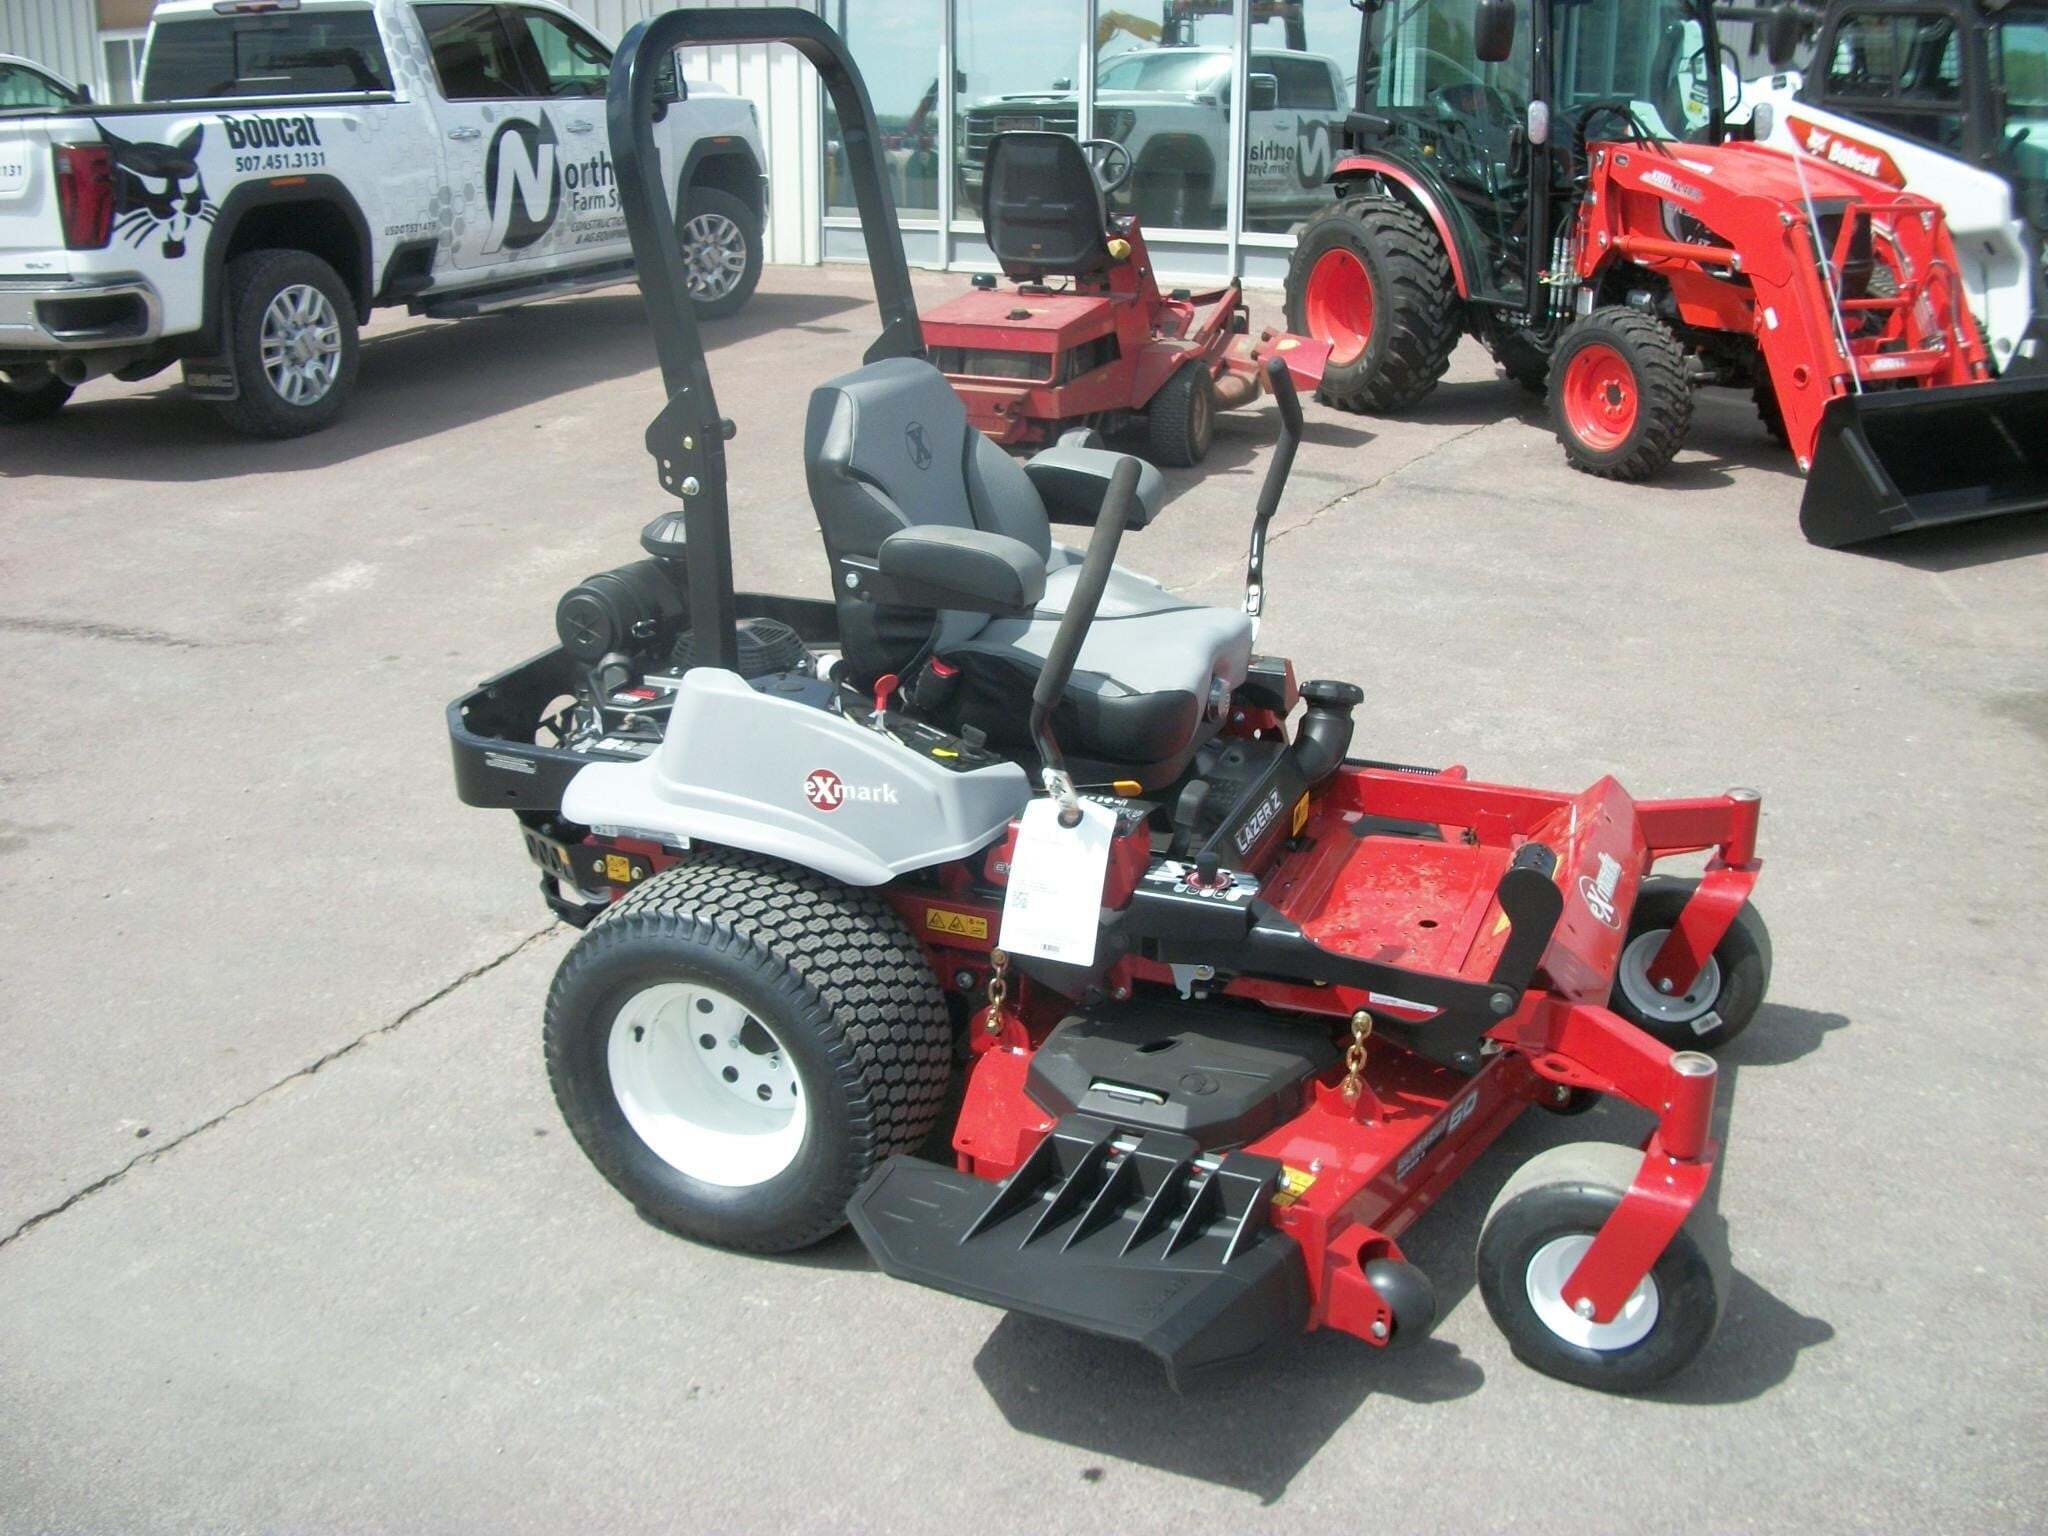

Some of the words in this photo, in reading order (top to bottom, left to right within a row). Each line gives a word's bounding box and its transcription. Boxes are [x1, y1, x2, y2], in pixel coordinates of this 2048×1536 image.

[216, 113, 321, 149] Bobcat
[235, 151, 326, 173] 507.451.3131
[1828, 140, 1881, 177] Bobcat
[572, 191, 606, 212] Farm
[1236, 801, 1273, 853] LAZER
[1270, 790, 1282, 810] Z
